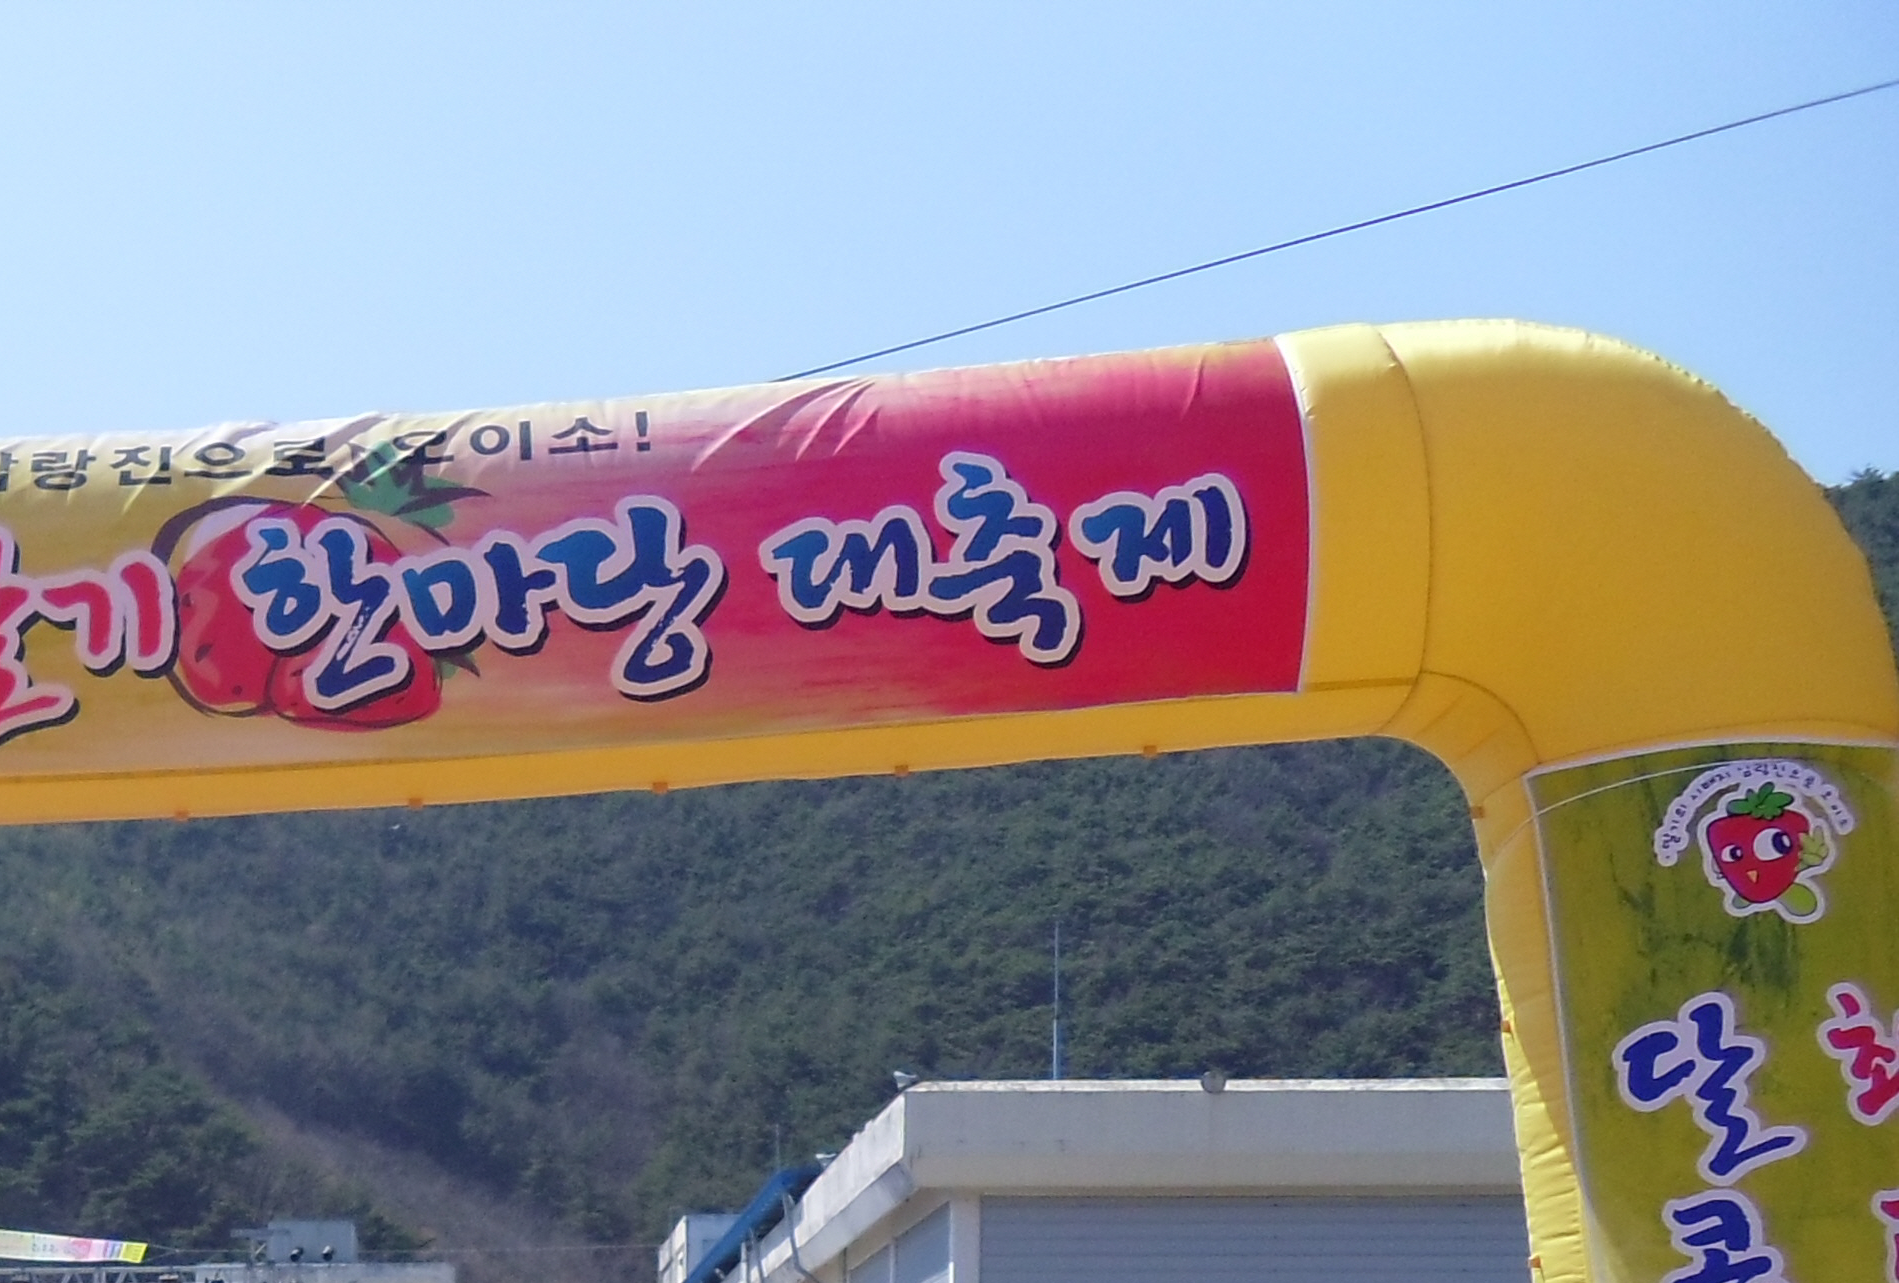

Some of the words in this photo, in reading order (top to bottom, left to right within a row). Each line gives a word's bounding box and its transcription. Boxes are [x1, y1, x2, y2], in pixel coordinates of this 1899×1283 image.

[392, 410, 652, 466] 오이소!
[235, 498, 719, 704] 한마당
[763, 455, 1243, 660] 대축제
